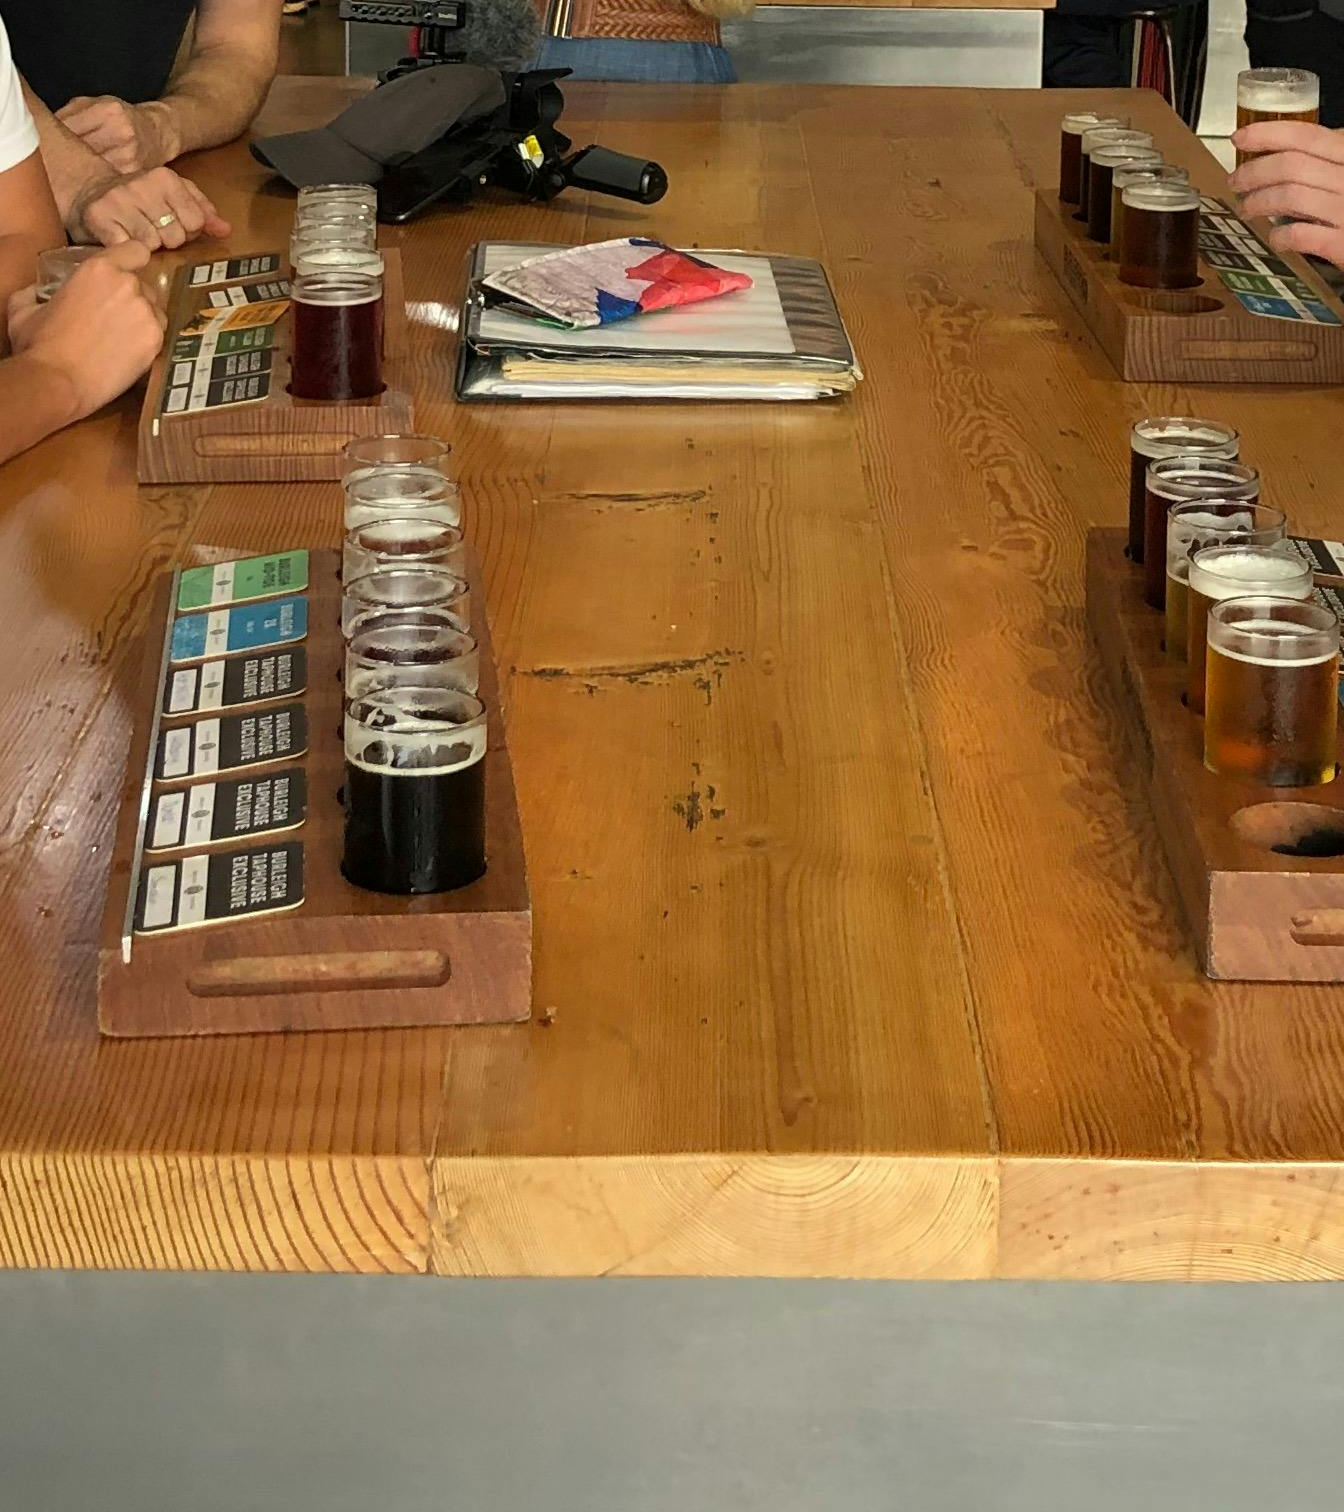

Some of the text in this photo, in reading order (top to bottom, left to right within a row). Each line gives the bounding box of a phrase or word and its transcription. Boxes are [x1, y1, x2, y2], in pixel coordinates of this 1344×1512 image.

[277, 654, 292, 690] BURLEIGH
[240, 717, 256, 761] EXCLUSIVE
[258, 714, 274, 756] TAPHOUSE
[275, 712, 291, 752] BURLEIGH
[234, 783, 253, 831] EXCLUSIVE
[253, 779, 271, 826] TAPHOUSE
[272, 777, 290, 822] BURLEIGH
[230, 855, 249, 910] EXCLUSIVE
[250, 852, 268, 904] TAPHOUSE
[270, 850, 288, 899] BURLEIGH
